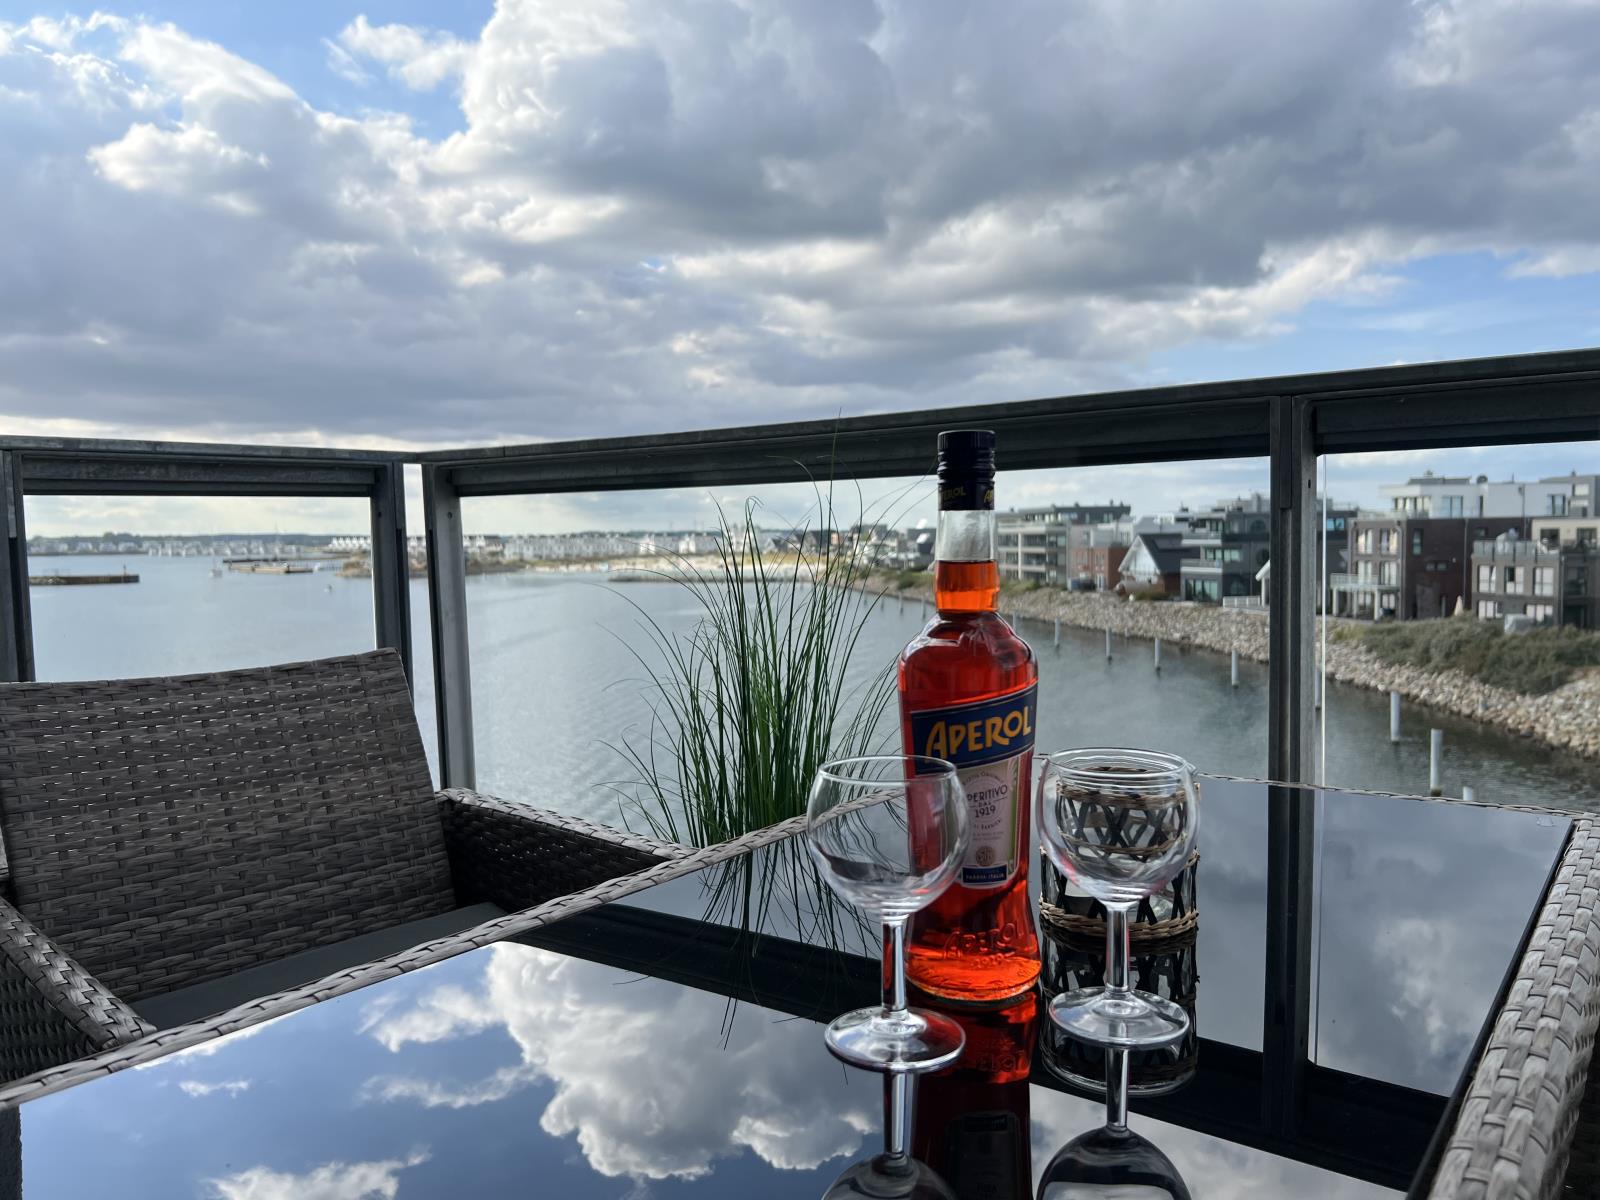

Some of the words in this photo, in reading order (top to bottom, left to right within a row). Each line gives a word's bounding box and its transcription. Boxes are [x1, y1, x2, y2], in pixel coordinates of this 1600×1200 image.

[925, 706, 1031, 761] APEROL
[966, 785, 1008, 803] PERITIVO
[975, 805, 996, 818] 1919
